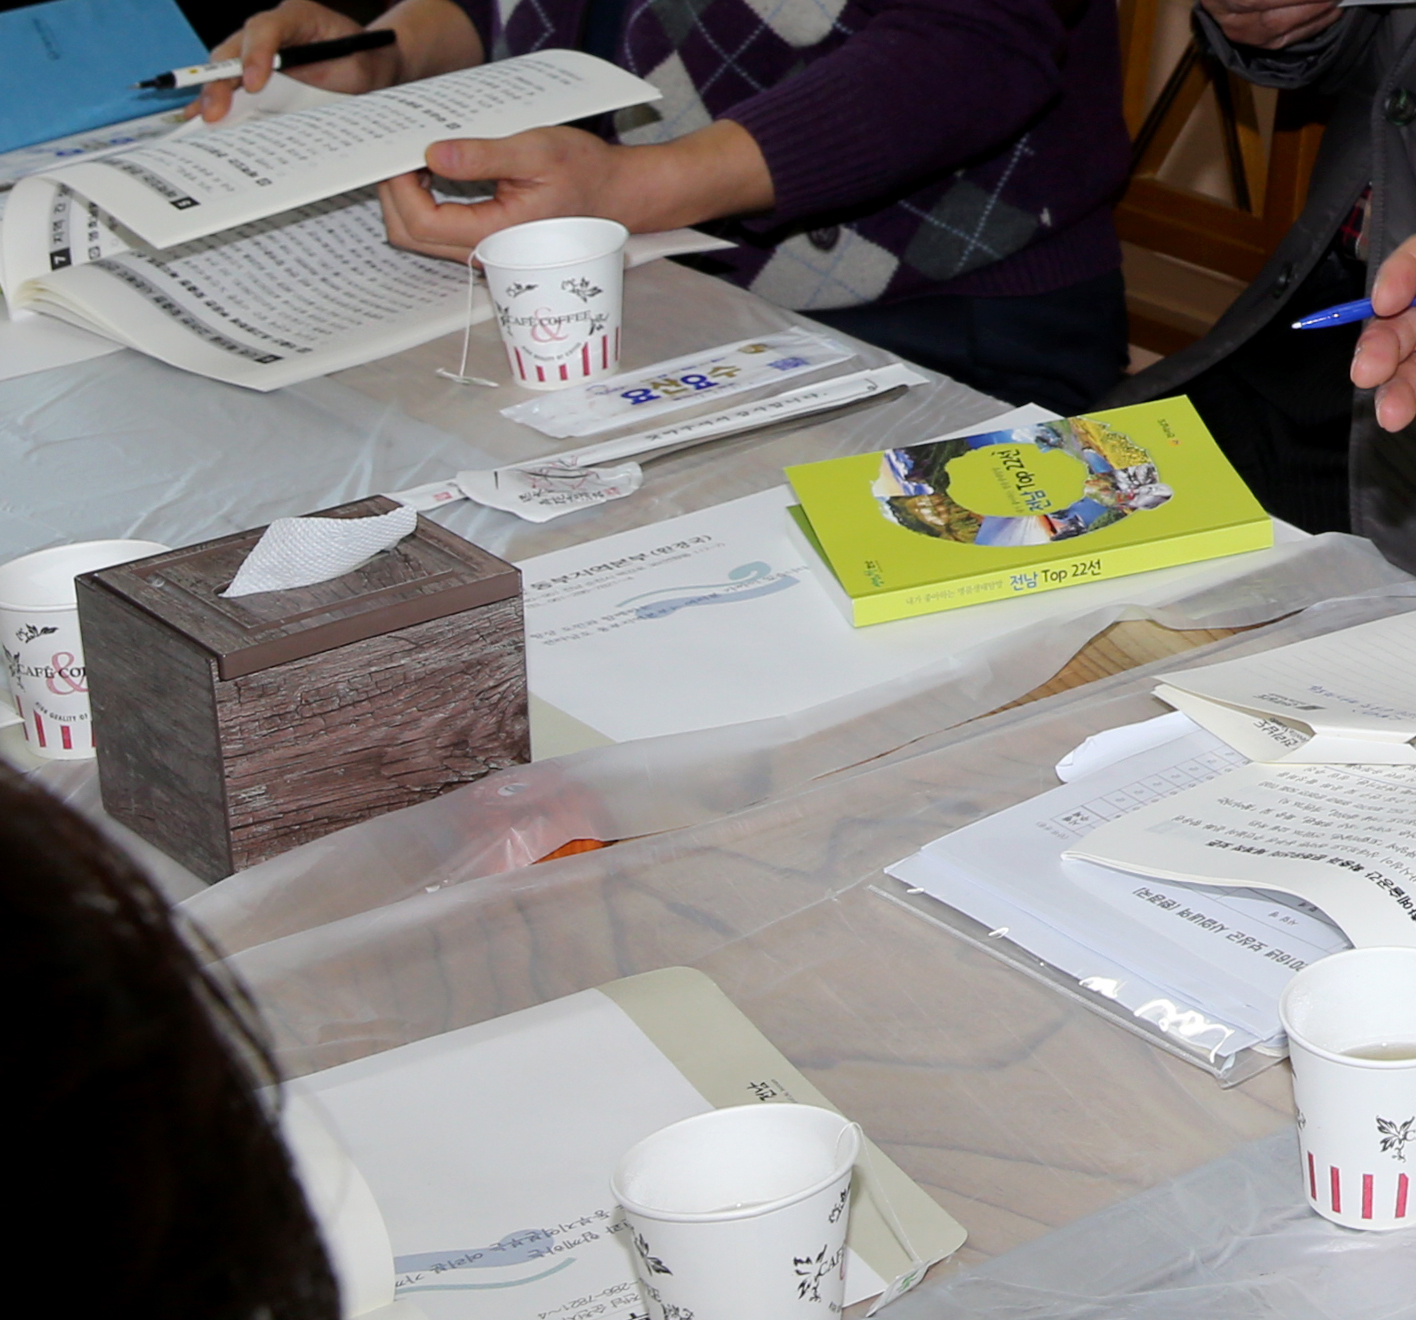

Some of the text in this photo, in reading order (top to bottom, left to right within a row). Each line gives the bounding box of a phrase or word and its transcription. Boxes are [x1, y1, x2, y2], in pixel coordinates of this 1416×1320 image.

[54, 255, 66, 265] 7
[540, 310, 592, 326] COFFEE
[620, 364, 741, 406] 요산요수
[990, 447, 1024, 470] 22선
[1014, 468, 1036, 492] Top
[1019, 489, 1053, 513] 전남
[1009, 573, 1038, 592] 전남
[1041, 567, 1068, 585] Top
[1071, 558, 1103, 579] 22선
[17, 664, 54, 679] CAFÉ
[46, 652, 90, 695] &
[1130, 887, 1182, 912] (환경국)
[1175, 902, 1229, 934] 사업내역
[1224, 930, 1267, 952] 보성군
